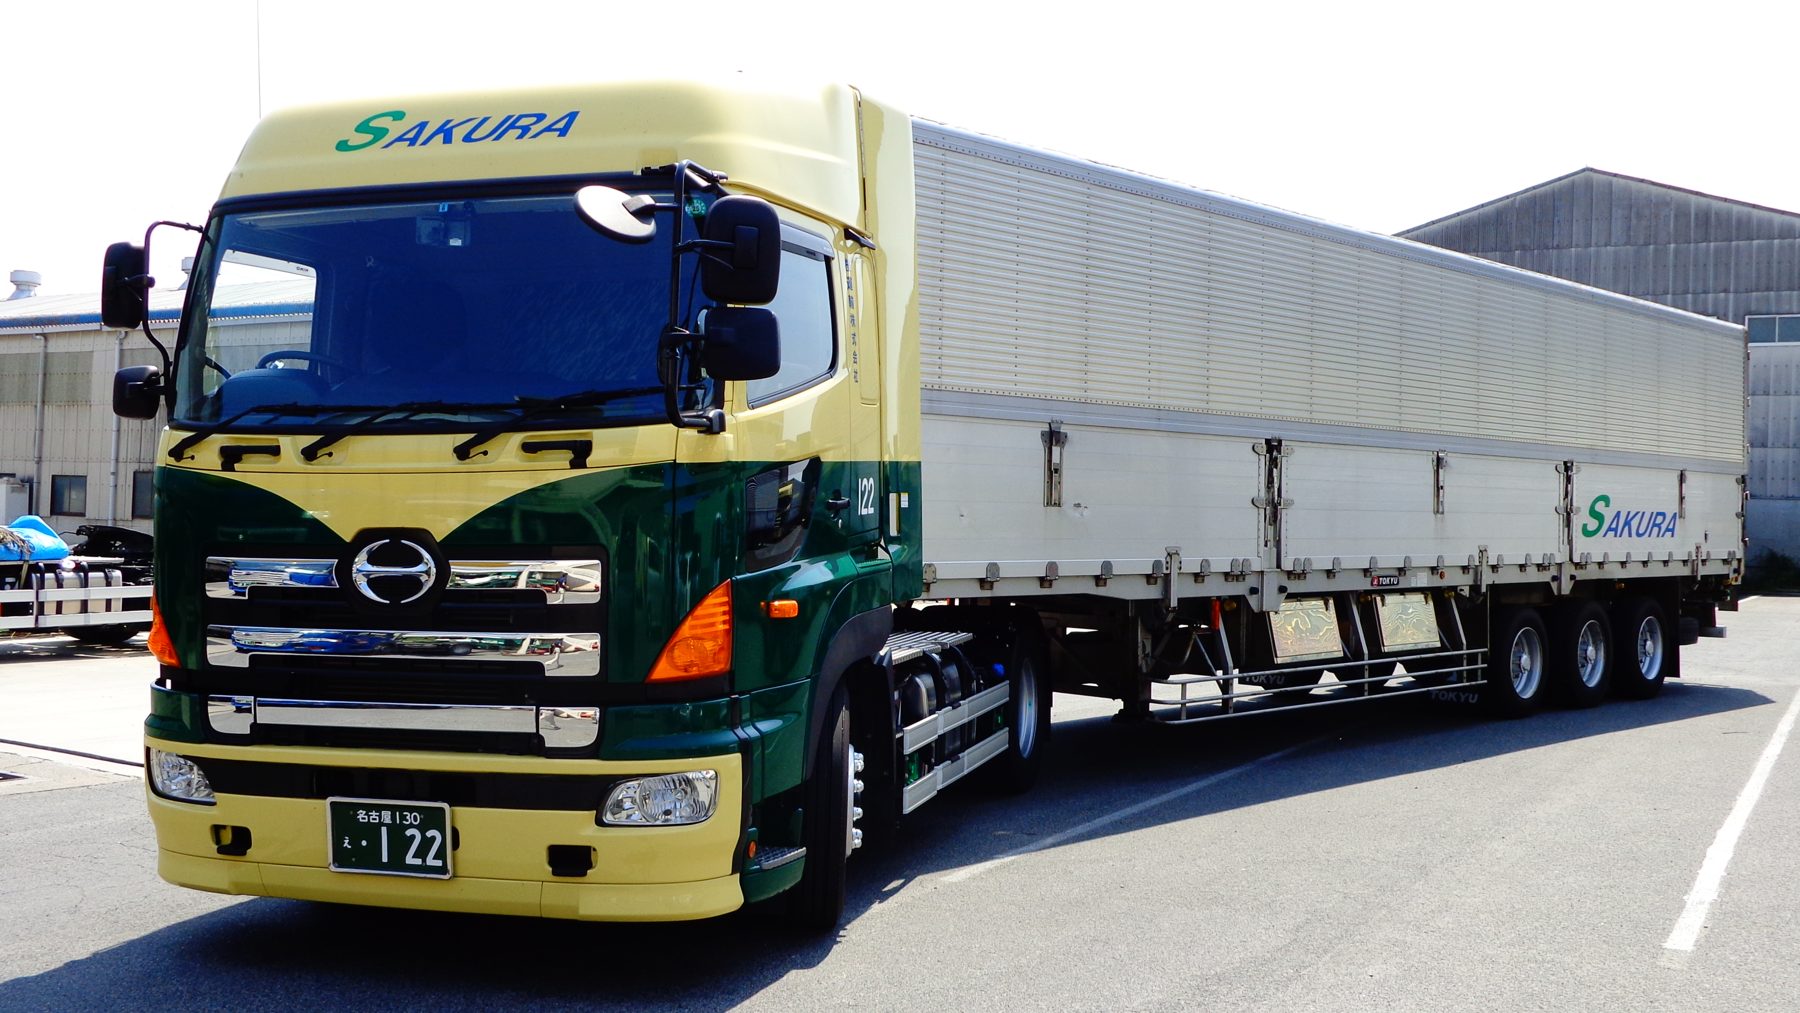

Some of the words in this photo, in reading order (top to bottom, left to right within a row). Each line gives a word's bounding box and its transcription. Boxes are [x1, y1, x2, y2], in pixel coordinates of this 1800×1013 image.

[335, 110, 580, 152] SAKURA
[858, 477, 875, 516] 122
[1581, 494, 1678, 538] SAKURA
[1379, 577, 1399, 585] TOKYU
[1431, 690, 1479, 704] TOKYU
